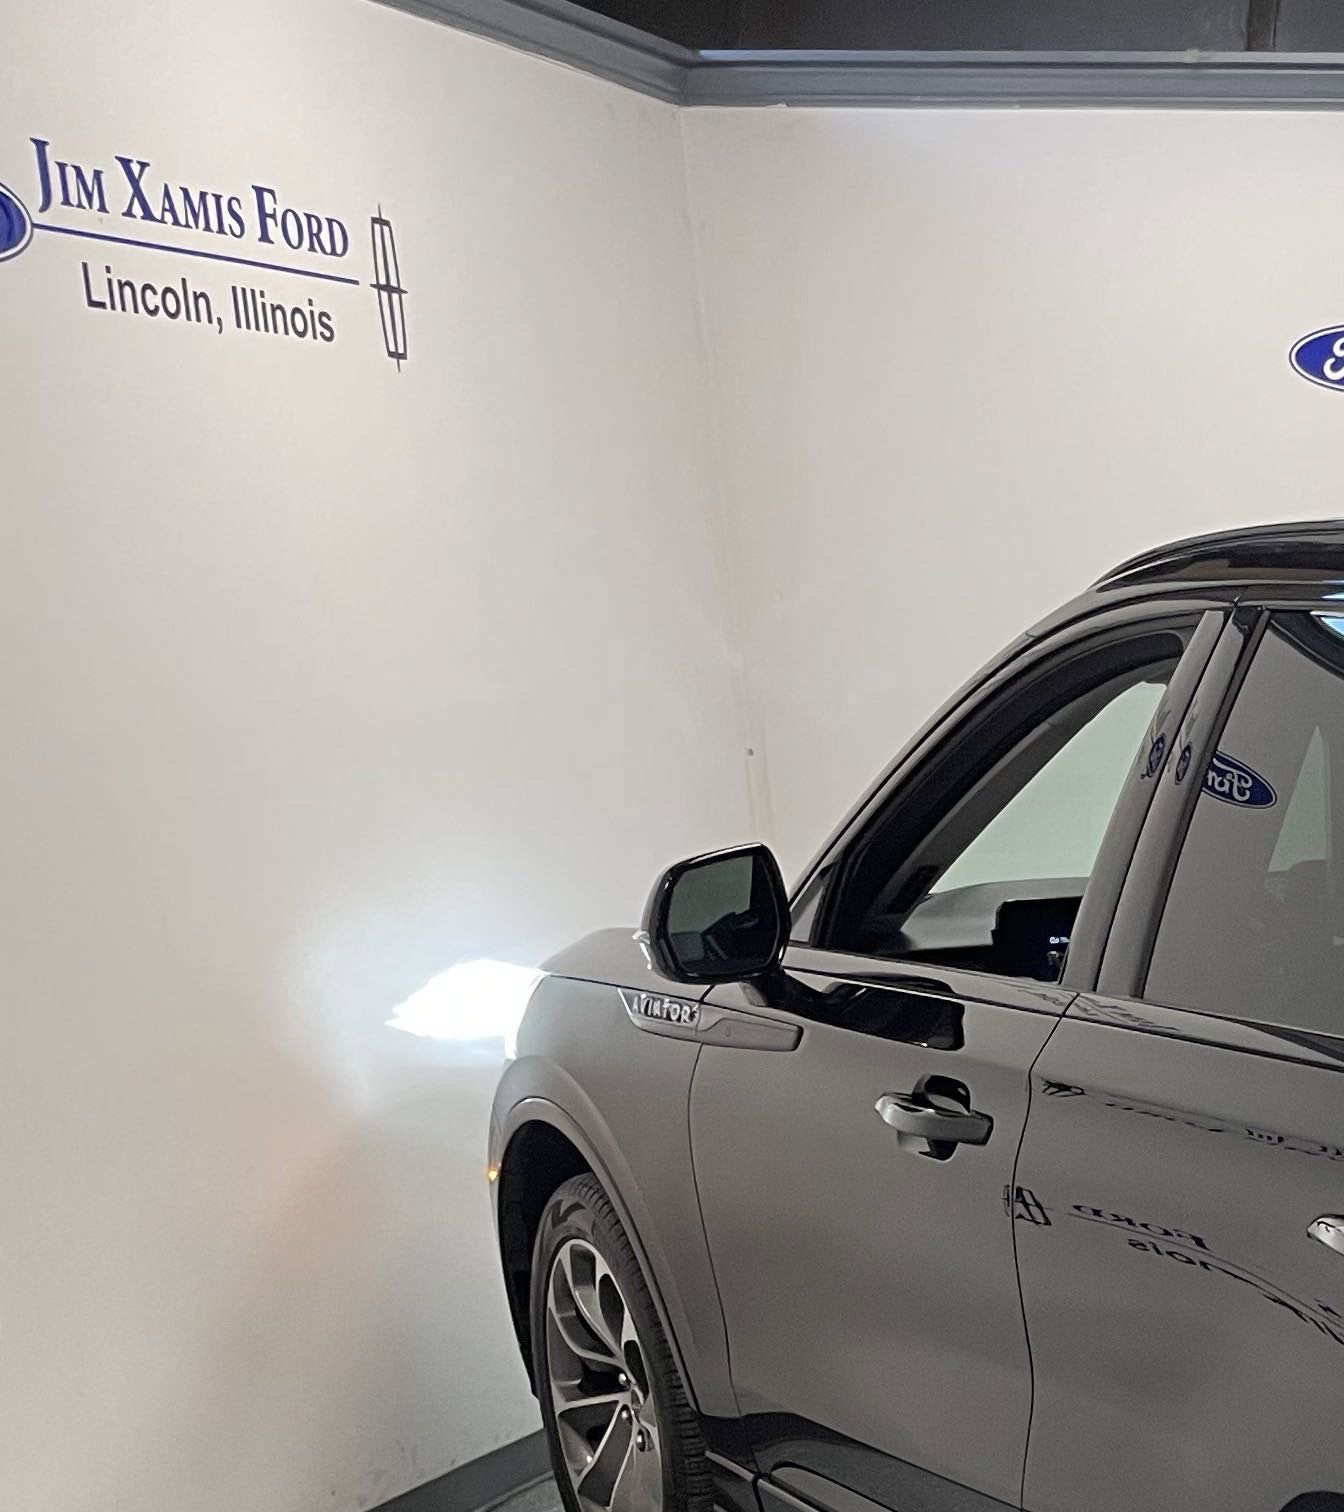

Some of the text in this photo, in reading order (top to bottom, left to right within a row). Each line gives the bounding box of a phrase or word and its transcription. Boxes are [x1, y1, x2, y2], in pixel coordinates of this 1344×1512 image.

[30, 137, 350, 259] JIM XAMIS FORD
[81, 261, 336, 343] Lincoln, Illinois
